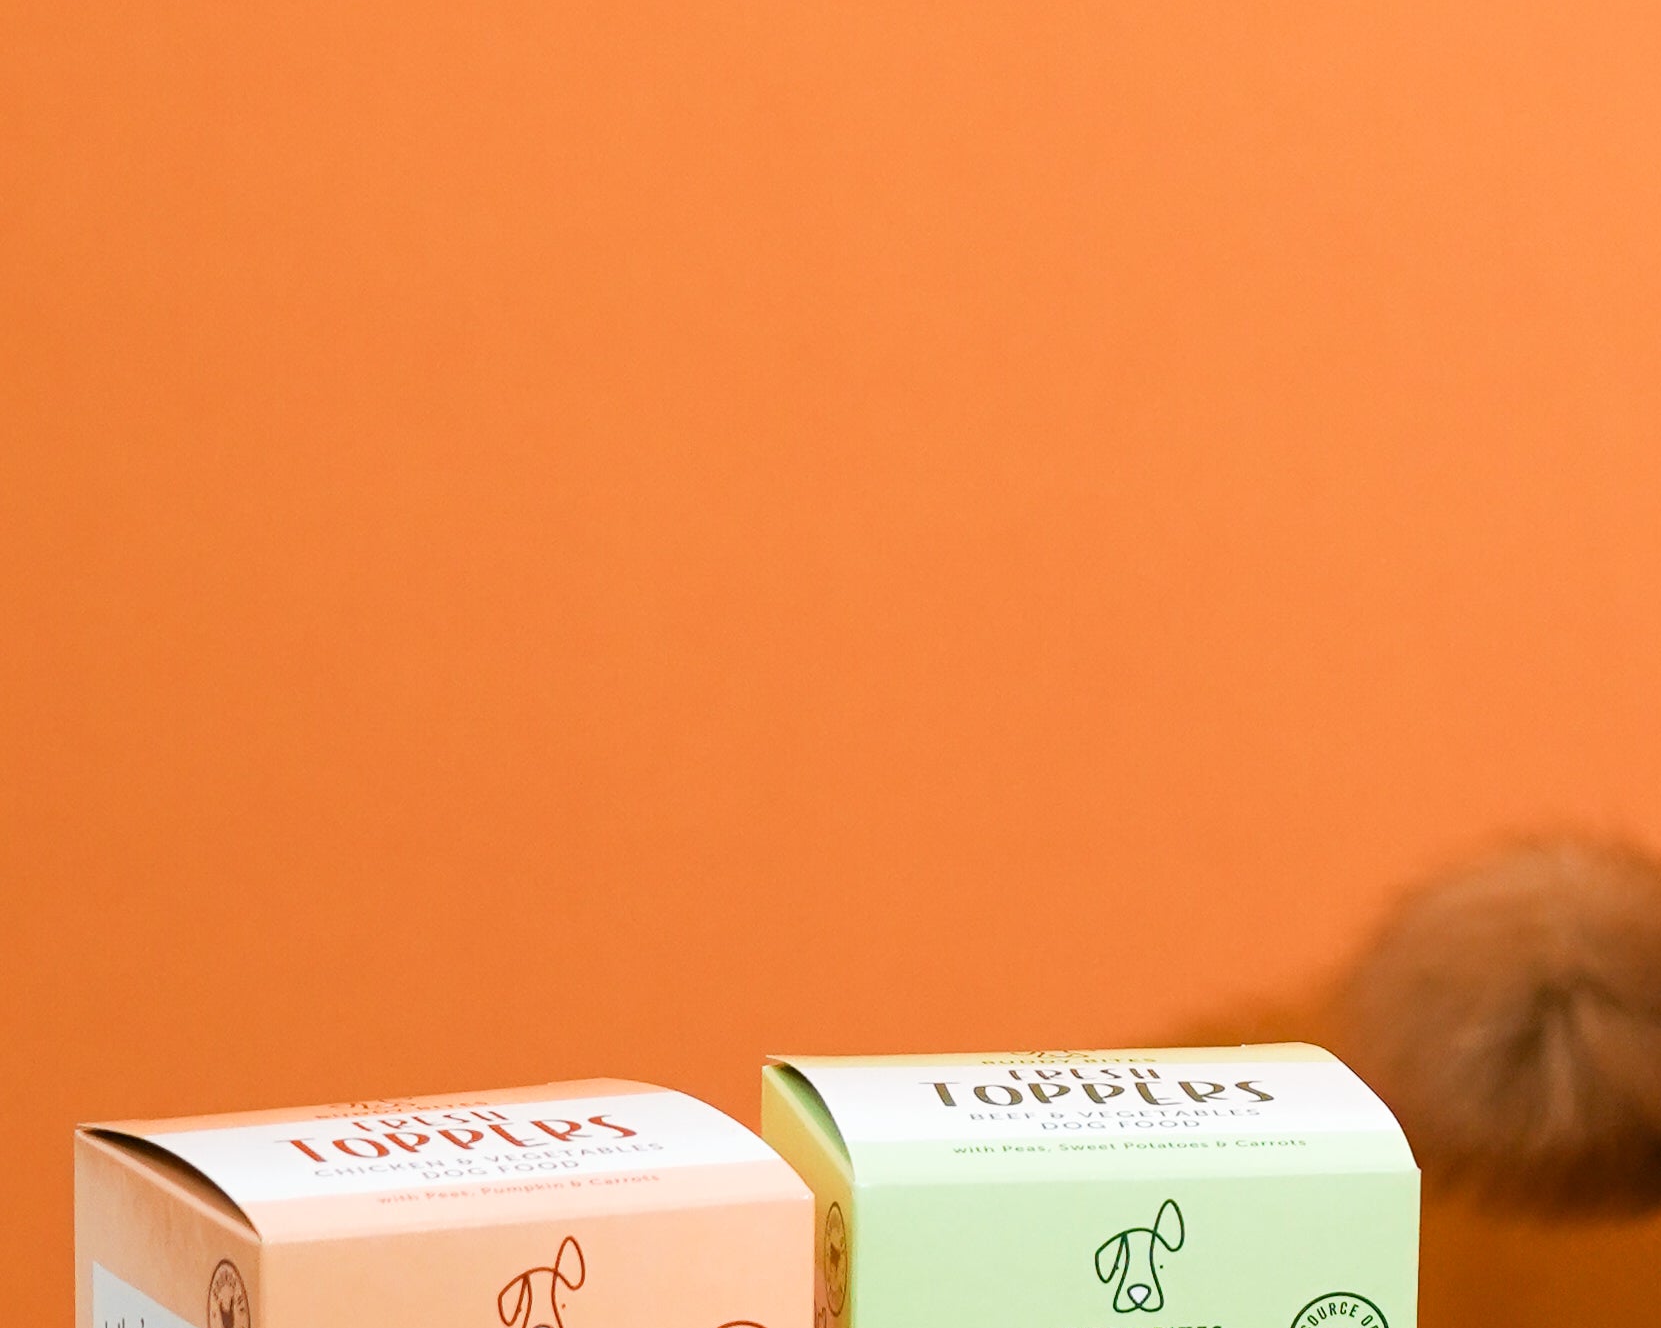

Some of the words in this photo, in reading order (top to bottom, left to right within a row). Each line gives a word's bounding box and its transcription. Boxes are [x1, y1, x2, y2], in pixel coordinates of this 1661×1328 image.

[1008, 1067, 1161, 1081] FRESH
[918, 1080, 1275, 1108] TOPPERS
[351, 1110, 511, 1132] FRESH
[970, 1111, 1036, 1121] BEEF
[1076, 1108, 1262, 1119] VEGETABLES
[1041, 1121, 1106, 1131] DOG
[1119, 1119, 1201, 1129] FOOD
[273, 1114, 639, 1163] TOPPERS
[953, 1144, 996, 1154] with
[1002, 1143, 1051, 1153] Peas,
[1059, 1142, 1116, 1152] Sweet
[1124, 1140, 1209, 1150] Potatoes
[1235, 1138, 1308, 1148] Carrots
[314, 1157, 445, 1178] CHICKEN
[484, 1141, 666, 1163] VEGETABLES
[422, 1165, 486, 1180] DOG
[499, 1158, 580, 1174] FOOD
[378, 1191, 420, 1204] with
[482, 1180, 563, 1196] Pumpkin
[589, 1173, 661, 1187] Carrots
